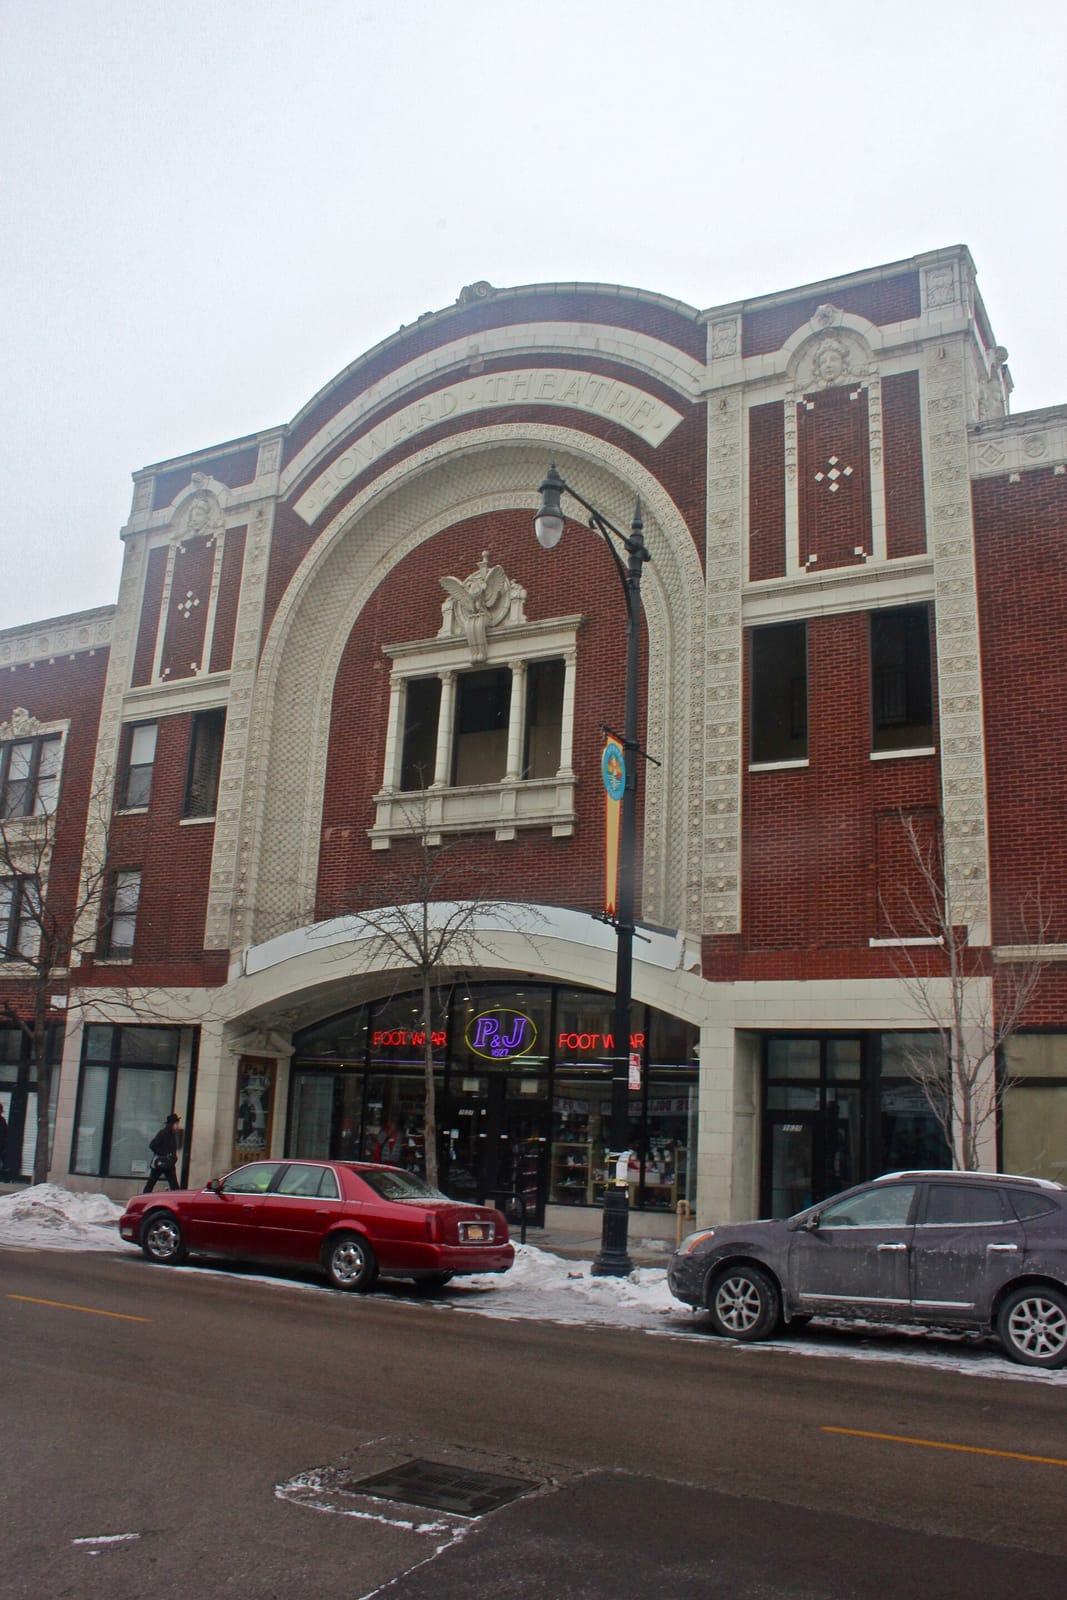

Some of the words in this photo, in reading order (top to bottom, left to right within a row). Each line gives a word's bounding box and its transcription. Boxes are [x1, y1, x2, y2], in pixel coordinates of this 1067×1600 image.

[312, 392, 458, 502] HOWARD
[486, 373, 657, 430] THEATRE
[373, 1031, 406, 1046] FOOT
[410, 1031, 448, 1047] WAR
[558, 1033, 600, 1049] FOOT
